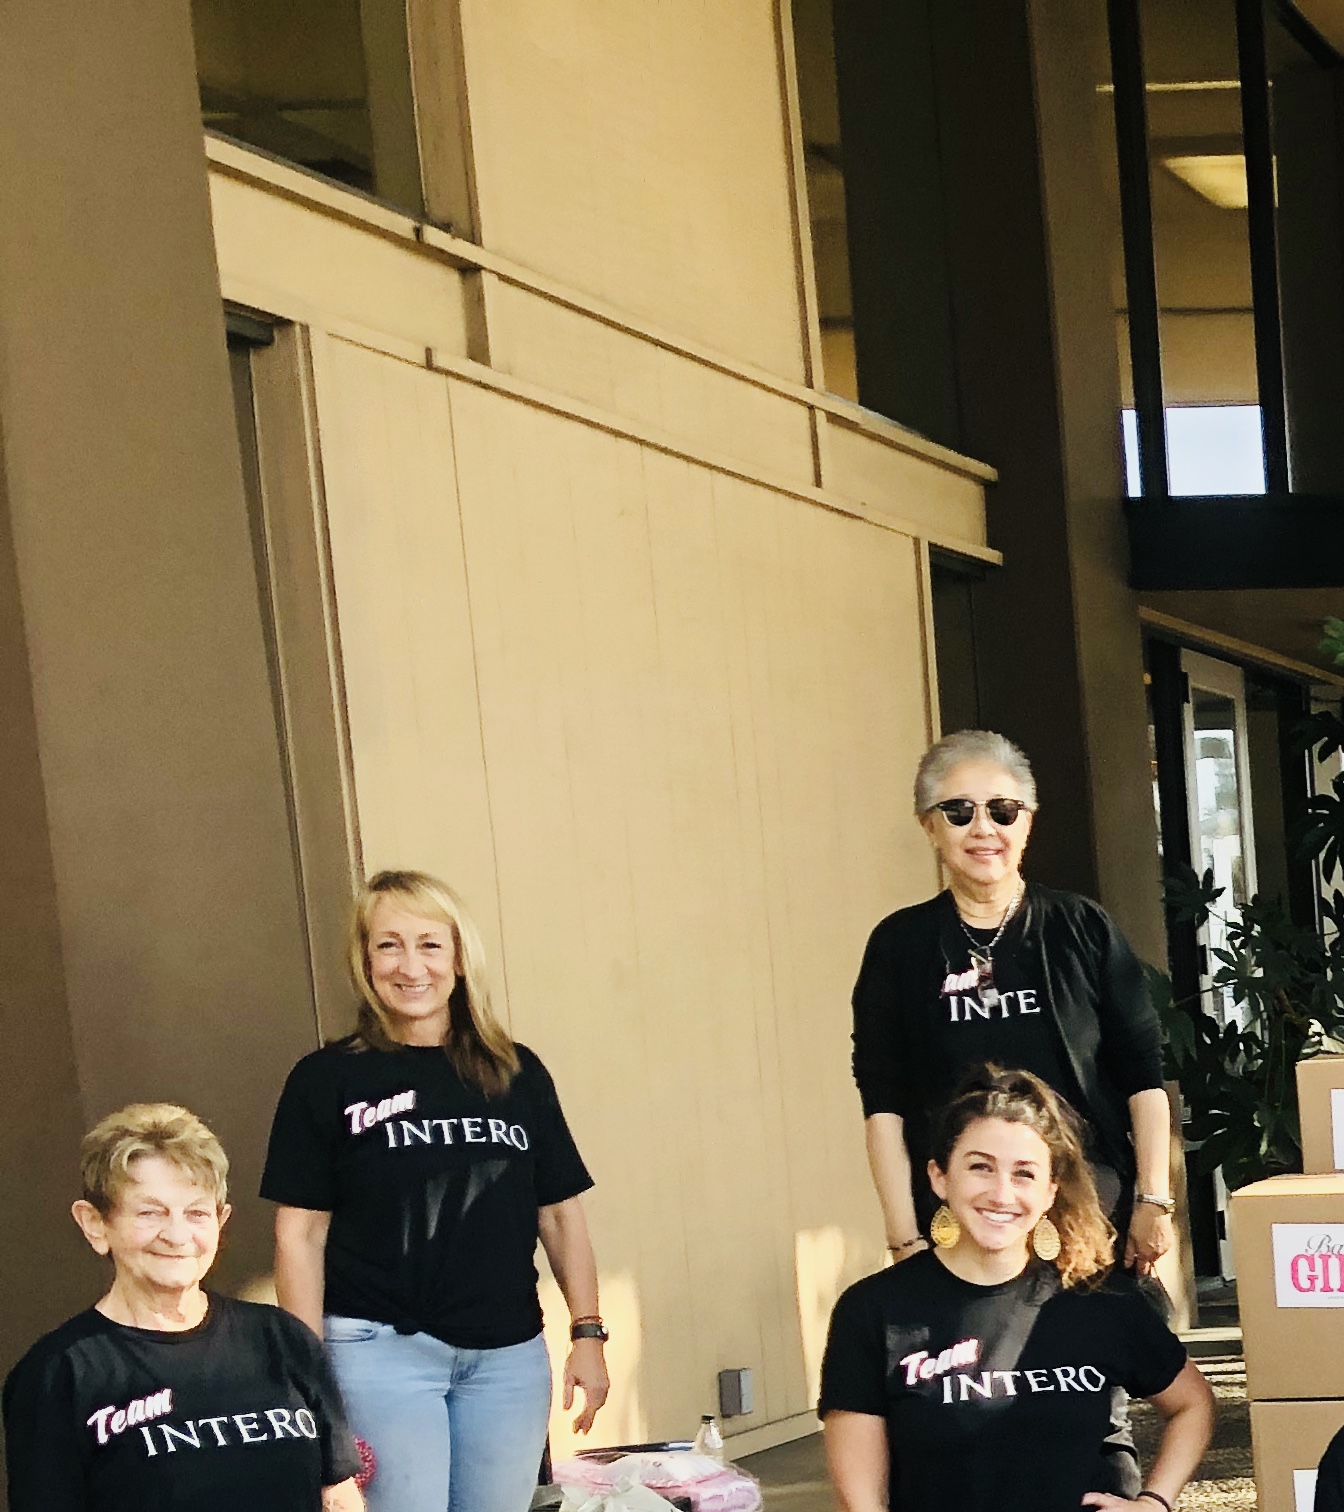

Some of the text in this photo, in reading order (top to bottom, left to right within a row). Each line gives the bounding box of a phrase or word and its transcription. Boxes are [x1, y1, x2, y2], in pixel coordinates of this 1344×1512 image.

[949, 989, 1041, 1021] INTE
[344, 1089, 417, 1135] Team
[385, 1117, 530, 1151] INTERO
[900, 1336, 980, 1386] Team
[942, 1365, 1106, 1404] INTERO
[86, 1387, 173, 1444] Team
[139, 1407, 318, 1458] INTERO
